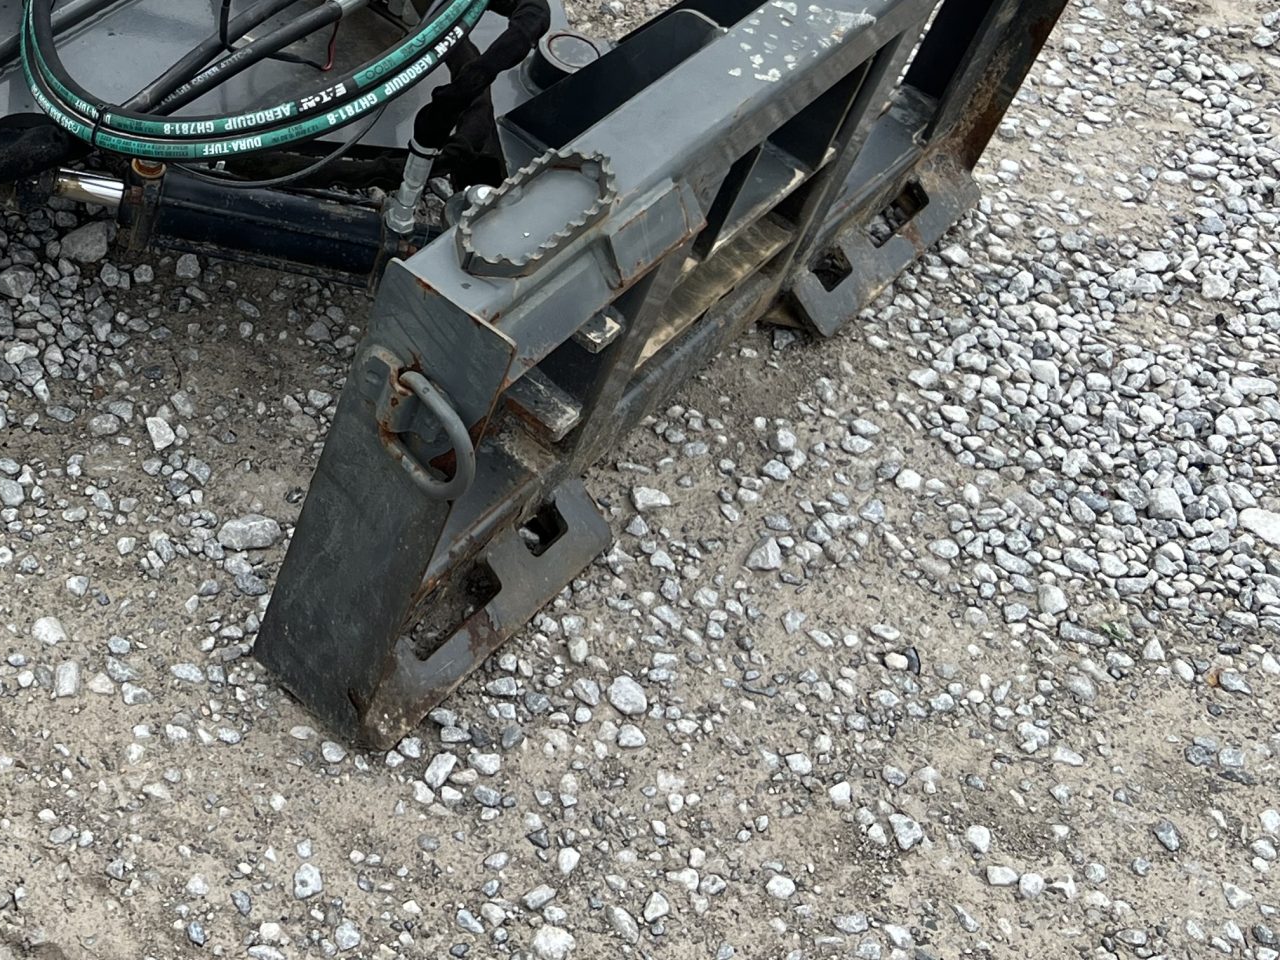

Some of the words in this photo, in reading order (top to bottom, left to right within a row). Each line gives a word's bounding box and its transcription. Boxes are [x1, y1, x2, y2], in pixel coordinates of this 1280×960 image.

[435, 26, 464, 58] EATON
[191, 66, 220, 86] COVER
[385, 55, 433, 95] AEROQUIP
[300, 83, 347, 112] EATON
[326, 93, 379, 125] GH781-8
[163, 121, 215, 135] GH781-8
[224, 102, 293, 131] AEROQUIP
[203, 137, 262, 155] DURA-TUFF
